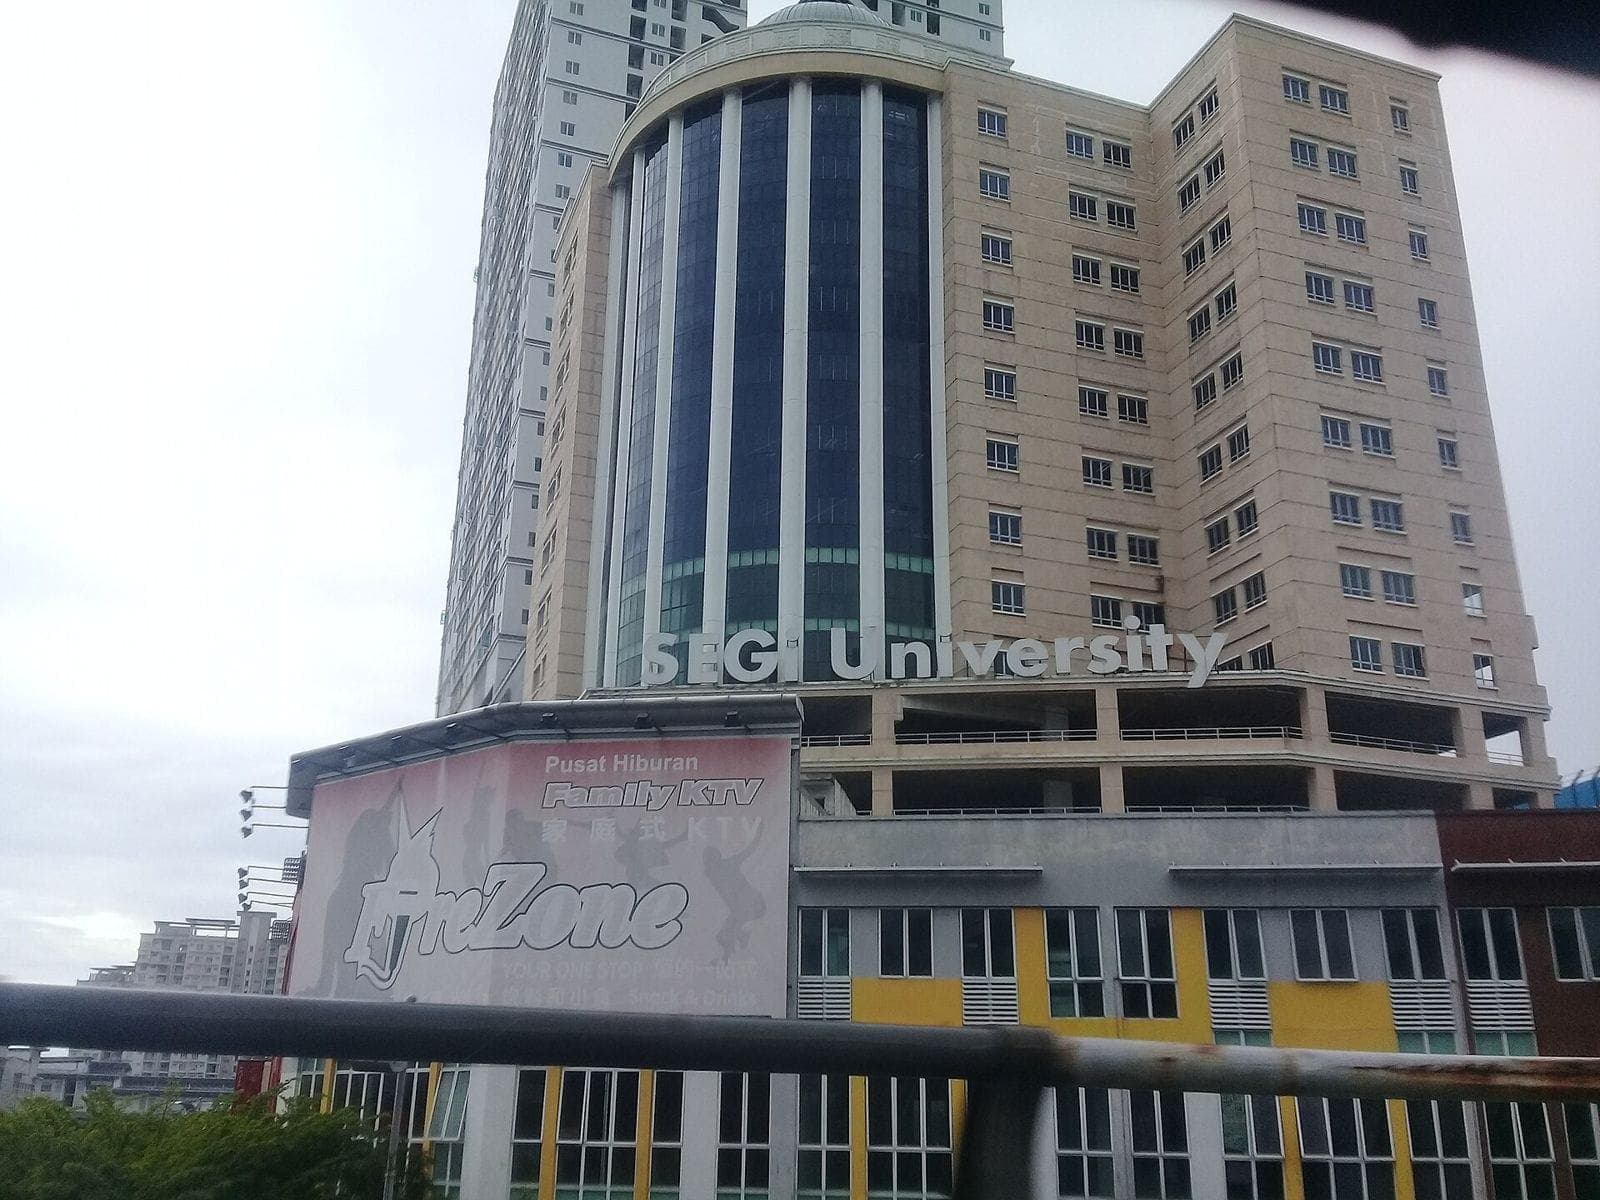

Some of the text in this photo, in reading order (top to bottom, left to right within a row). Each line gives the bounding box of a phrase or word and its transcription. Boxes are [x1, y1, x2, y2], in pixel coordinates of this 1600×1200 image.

[830, 615, 1229, 689] University
[545, 754, 698, 773] Pusat Hiburan
[541, 778, 765, 811] Family KTV
[556, 960, 594, 980] ONE
[597, 960, 643, 981] STOP
